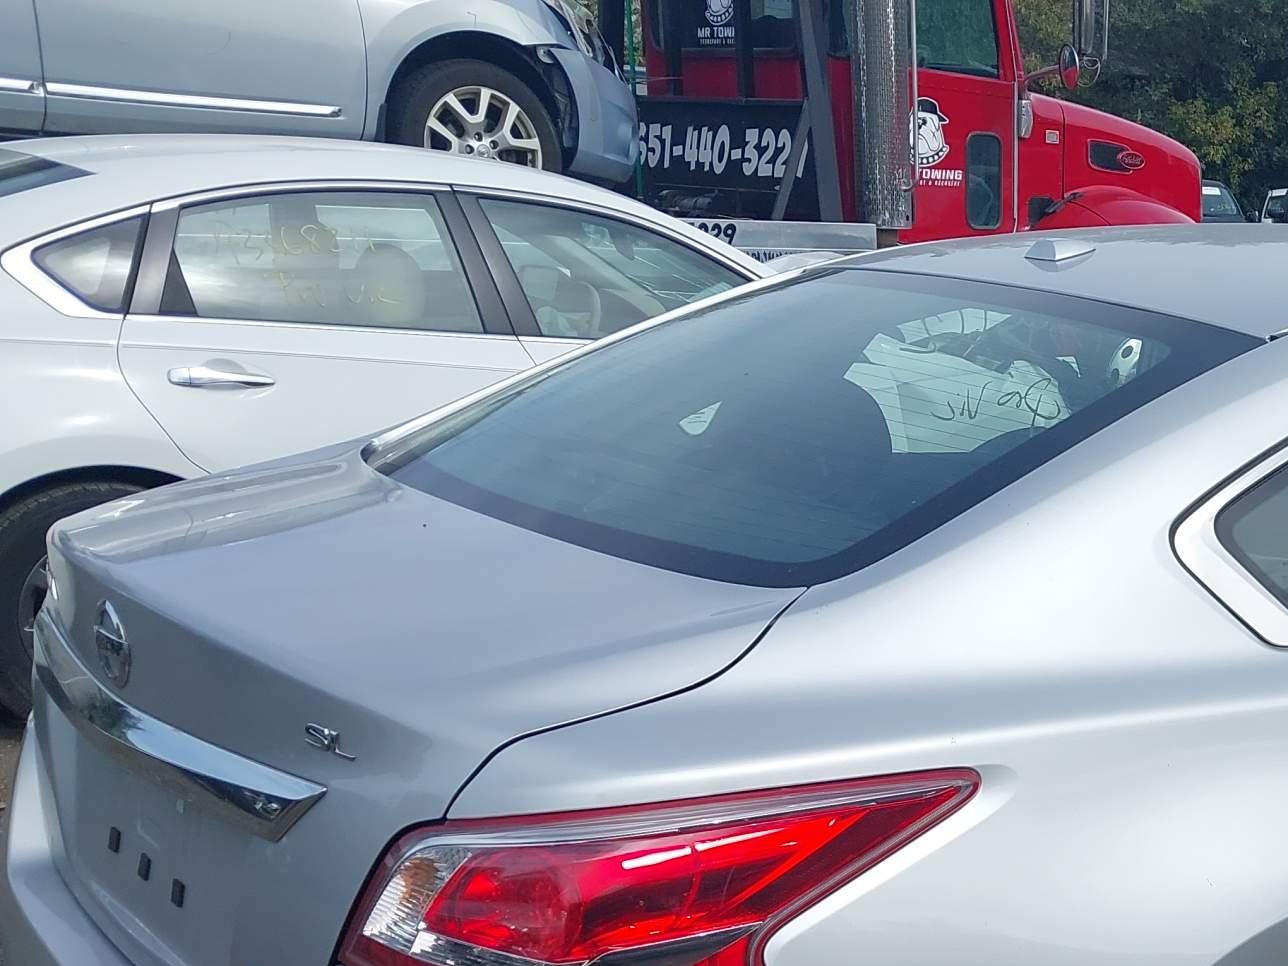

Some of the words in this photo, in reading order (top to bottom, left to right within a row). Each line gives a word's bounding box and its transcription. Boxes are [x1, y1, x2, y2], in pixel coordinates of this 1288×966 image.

[697, 27, 711, 38] MR
[713, 26, 735, 38] TOWI
[305, 722, 357, 761] SL
